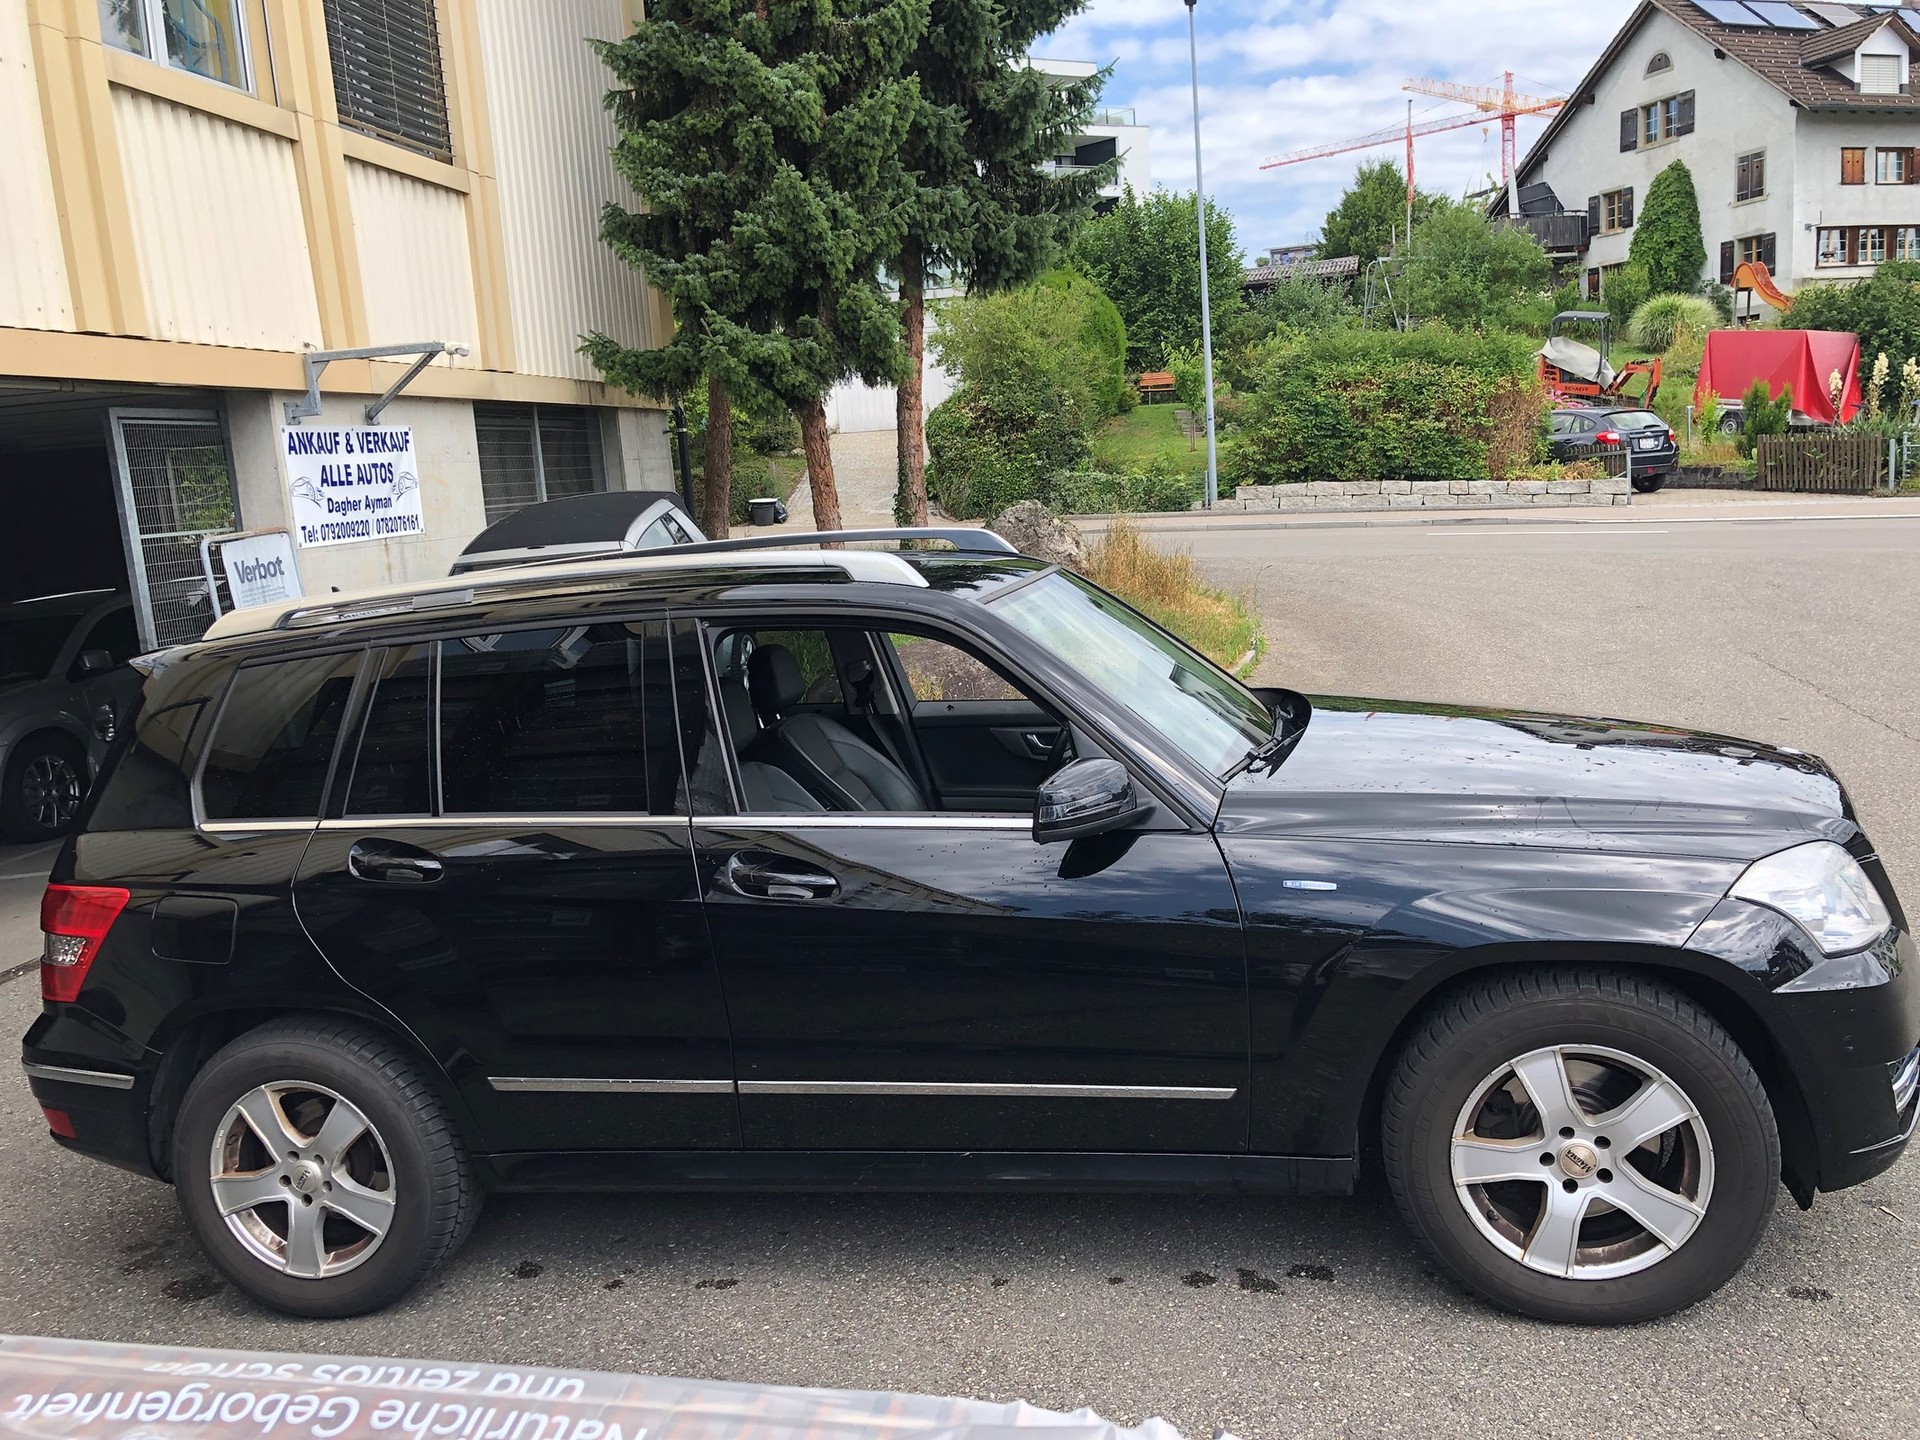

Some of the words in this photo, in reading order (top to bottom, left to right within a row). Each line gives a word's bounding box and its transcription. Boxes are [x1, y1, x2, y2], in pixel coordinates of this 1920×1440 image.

[288, 431, 340, 455] ANKAUF
[345, 432, 354, 454] &
[356, 431, 410, 454] VERKAUF
[320, 464, 353, 487] ALLE
[357, 462, 394, 485] AUTOS
[327, 496, 362, 516] Dagher
[364, 495, 393, 513] Ayman
[301, 525, 319, 543] Tel:
[320, 519, 371, 541] 0792009220
[376, 514, 420, 534] 0782076161
[233, 555, 285, 584] Verbot
[5, 1382, 361, 1438] Geborgenheit
